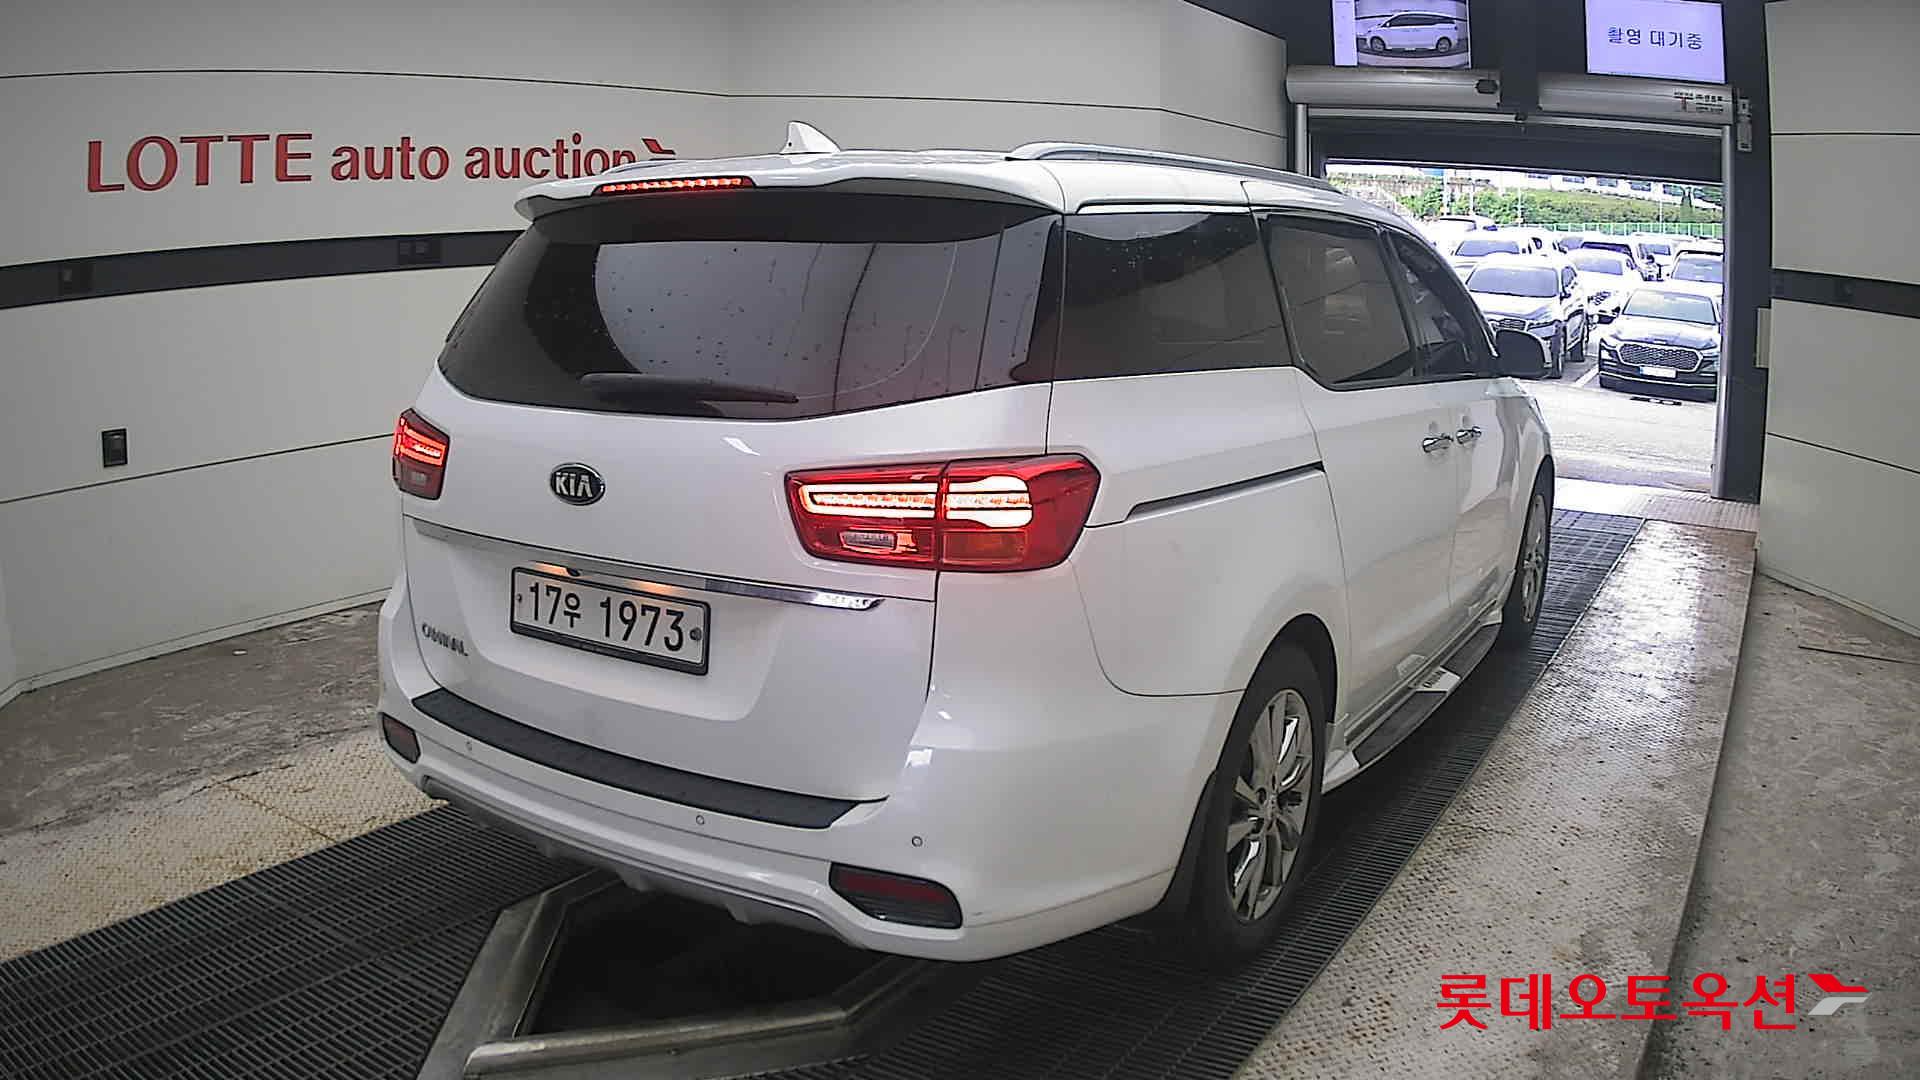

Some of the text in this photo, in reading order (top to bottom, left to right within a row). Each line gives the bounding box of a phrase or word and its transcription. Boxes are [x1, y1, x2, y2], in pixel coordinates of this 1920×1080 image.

[1650, 30, 1703, 50] 대기중
[87, 133, 312, 193] LOTTE
[331, 136, 449, 181] auto
[555, 472, 593, 497] KIA
[529, 582, 684, 651] 17우 1973
